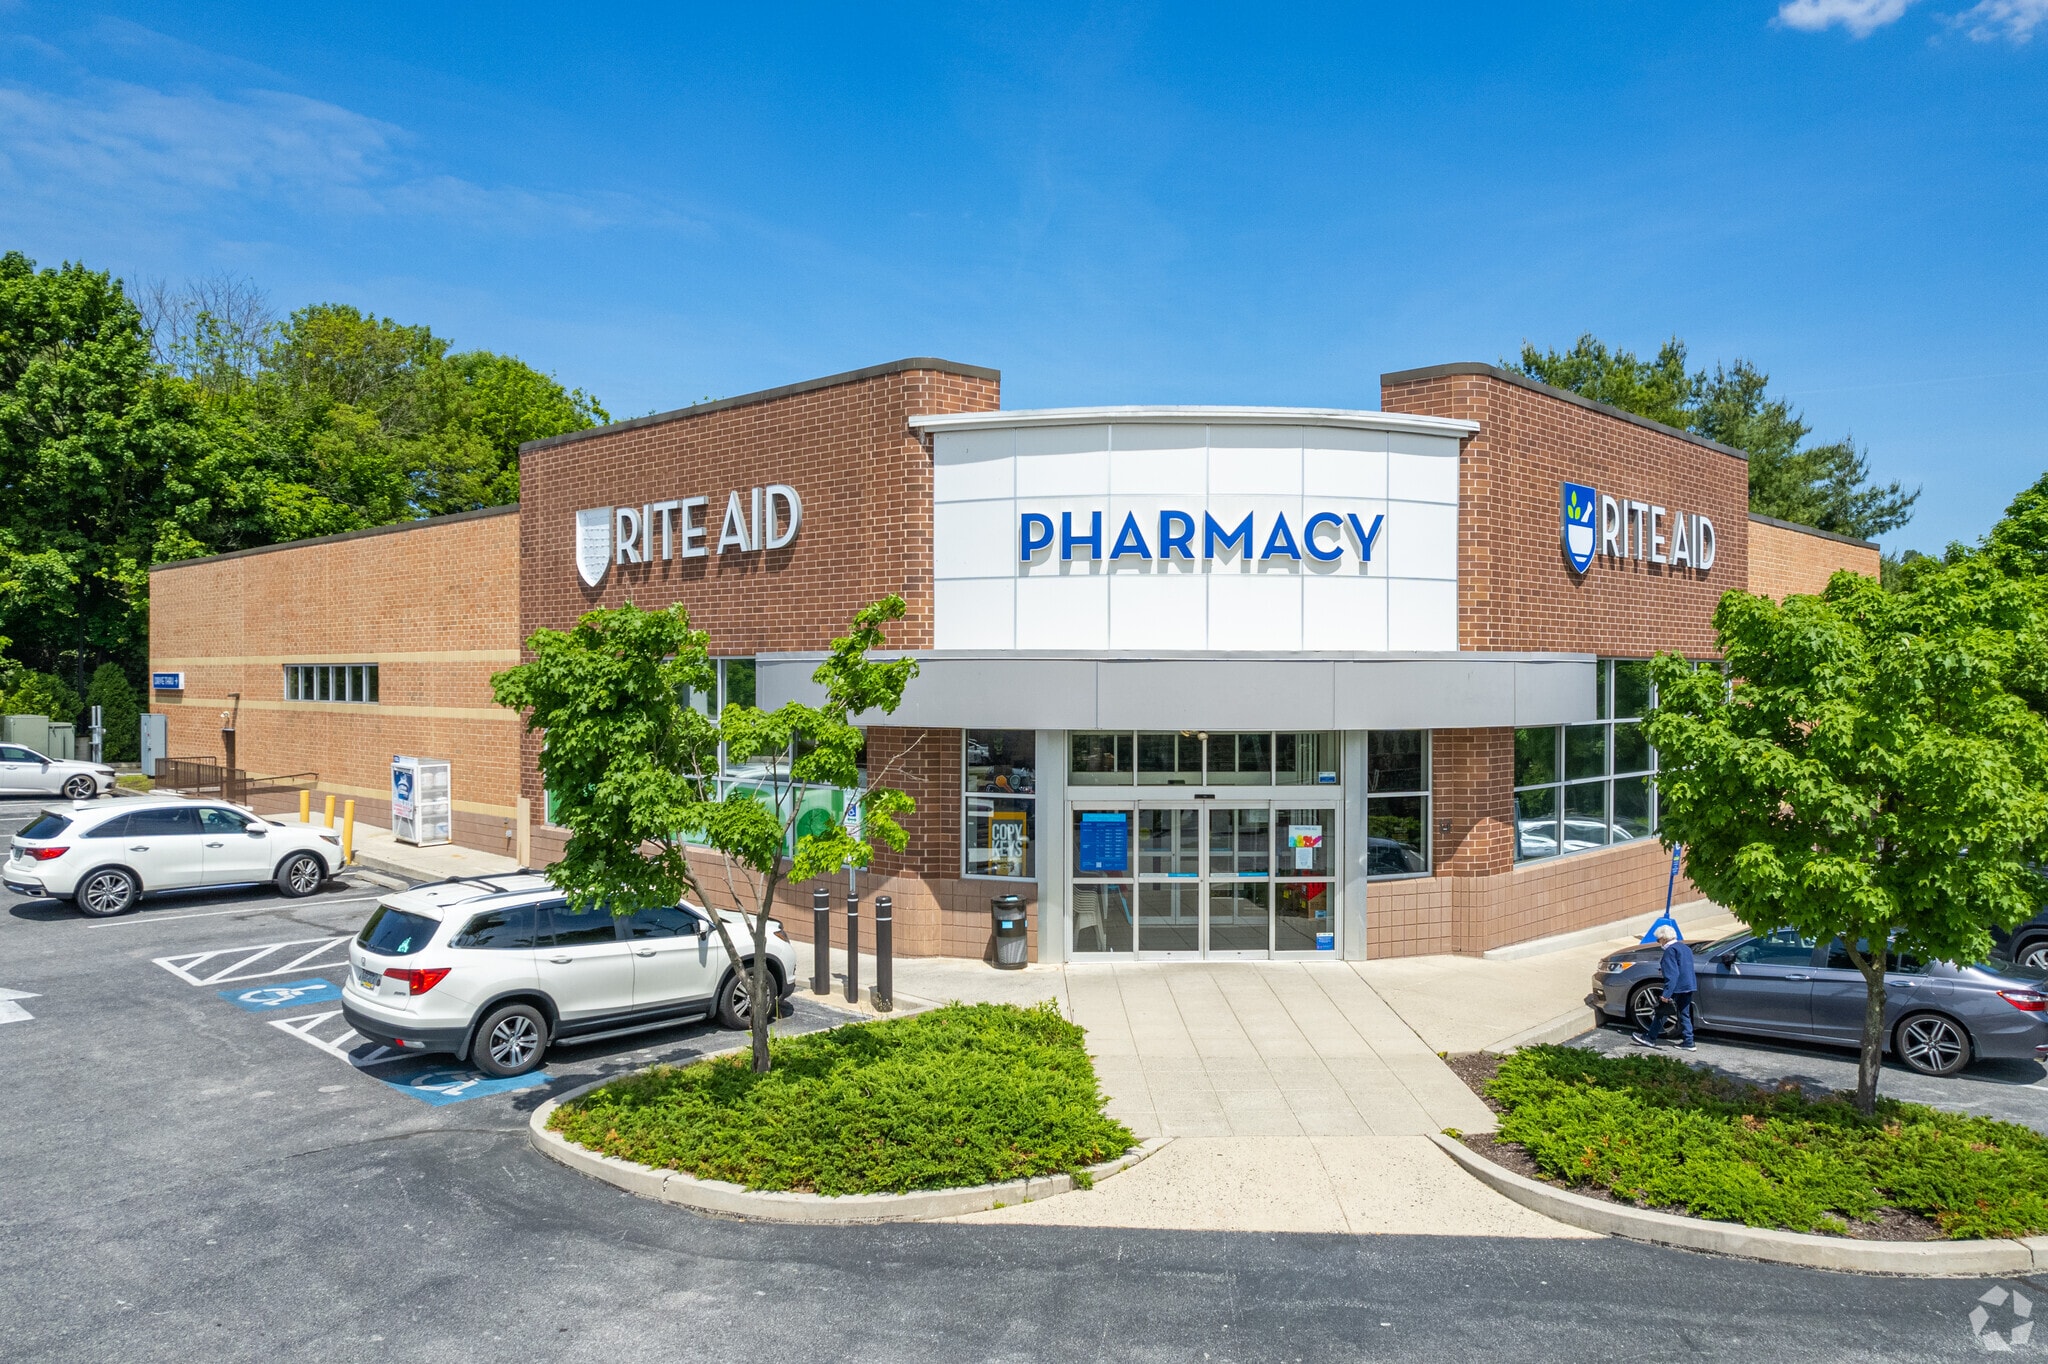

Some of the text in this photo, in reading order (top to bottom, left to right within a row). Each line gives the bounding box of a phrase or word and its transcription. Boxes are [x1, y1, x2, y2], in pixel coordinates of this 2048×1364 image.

[616, 484, 803, 565] RITE AID
[1019, 509, 1385, 563] PHARMACY
[1599, 494, 1716, 570] RITE AID
[992, 823, 1023, 840] COPY
[992, 840, 1023, 858] KEYS
